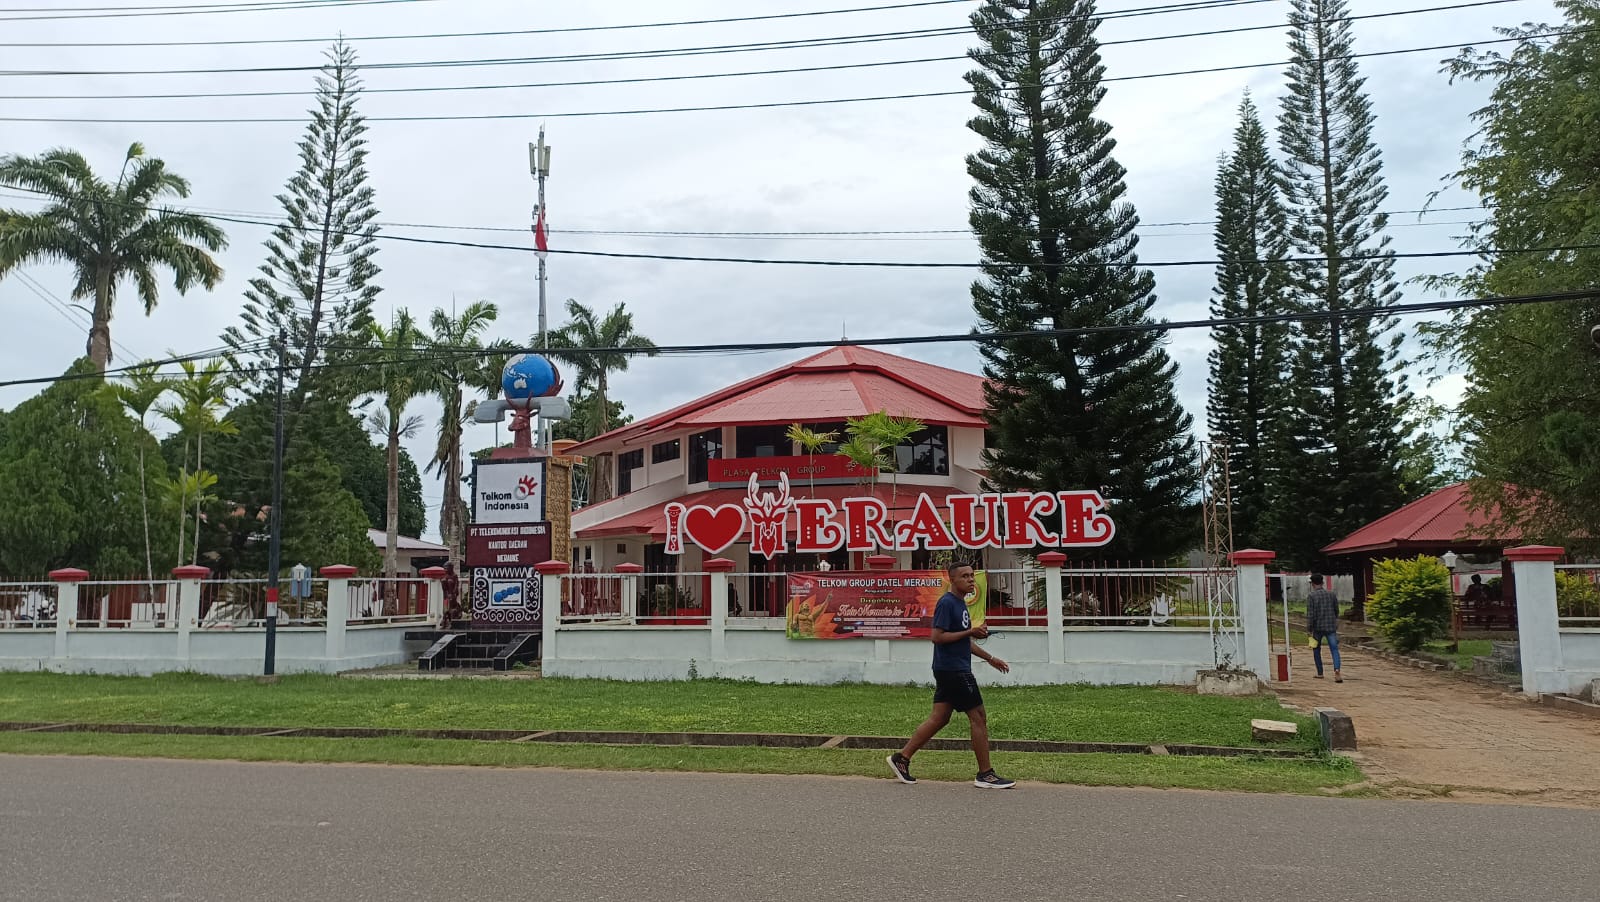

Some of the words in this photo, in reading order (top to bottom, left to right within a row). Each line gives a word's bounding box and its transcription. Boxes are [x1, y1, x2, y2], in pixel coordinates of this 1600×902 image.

[723, 468, 750, 478] PLASA
[756, 466, 790, 477] TELKOM
[797, 464, 826, 475] GROUP
[481, 492, 512, 501] Telkom
[484, 501, 529, 511] Indonesia
[664, 502, 686, 554] I
[744, 472, 1116, 560] MERAUKE
[470, 528, 478, 537] PT
[519, 525, 546, 535] INDONESIA
[488, 540, 507, 550] KANTOR
[508, 540, 528, 549] DAERAH
[496, 553, 520, 563] MERAUKE
[817, 579, 848, 588] TELKOM
[849, 579, 876, 588] GROUP
[877, 578, 902, 587] DATEL
[903, 578, 942, 588] MERAUKE
